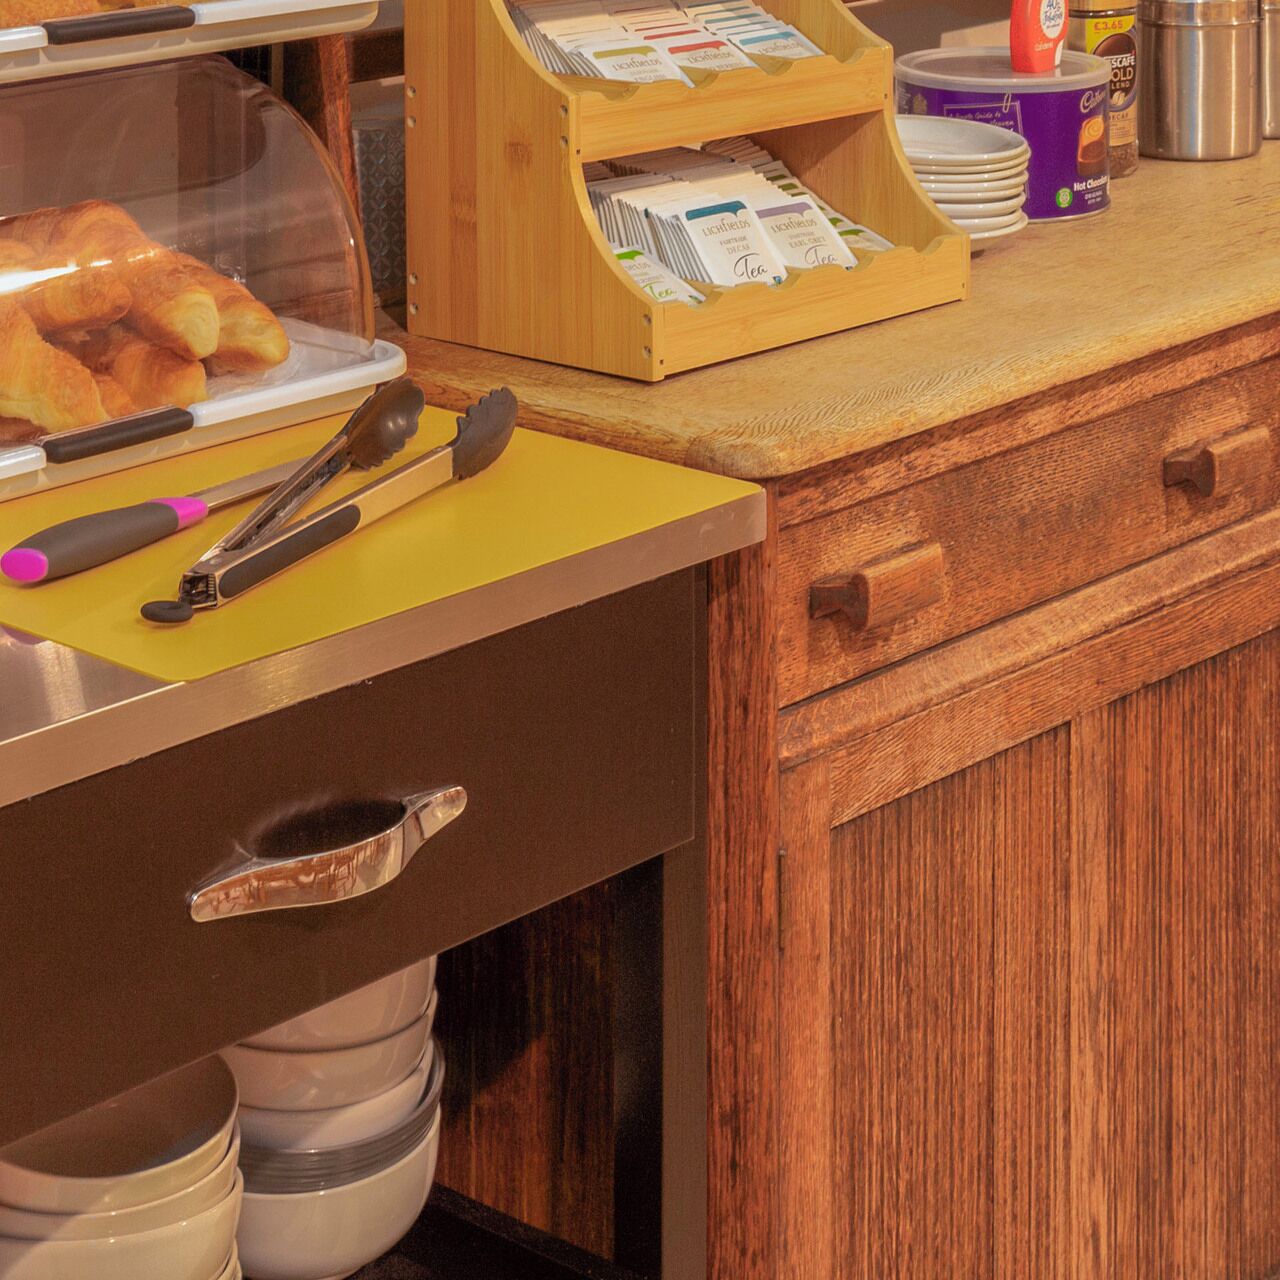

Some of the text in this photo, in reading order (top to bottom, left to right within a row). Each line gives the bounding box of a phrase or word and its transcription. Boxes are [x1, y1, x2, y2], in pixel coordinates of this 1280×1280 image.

[1094, 21, 1124, 31] £3.65
[1111, 67, 1134, 81] OLD
[1111, 81, 1131, 90] LEND
[1073, 181, 1086, 192] Hot
[804, 244, 838, 265] Tea
[733, 252, 768, 280] Tea
